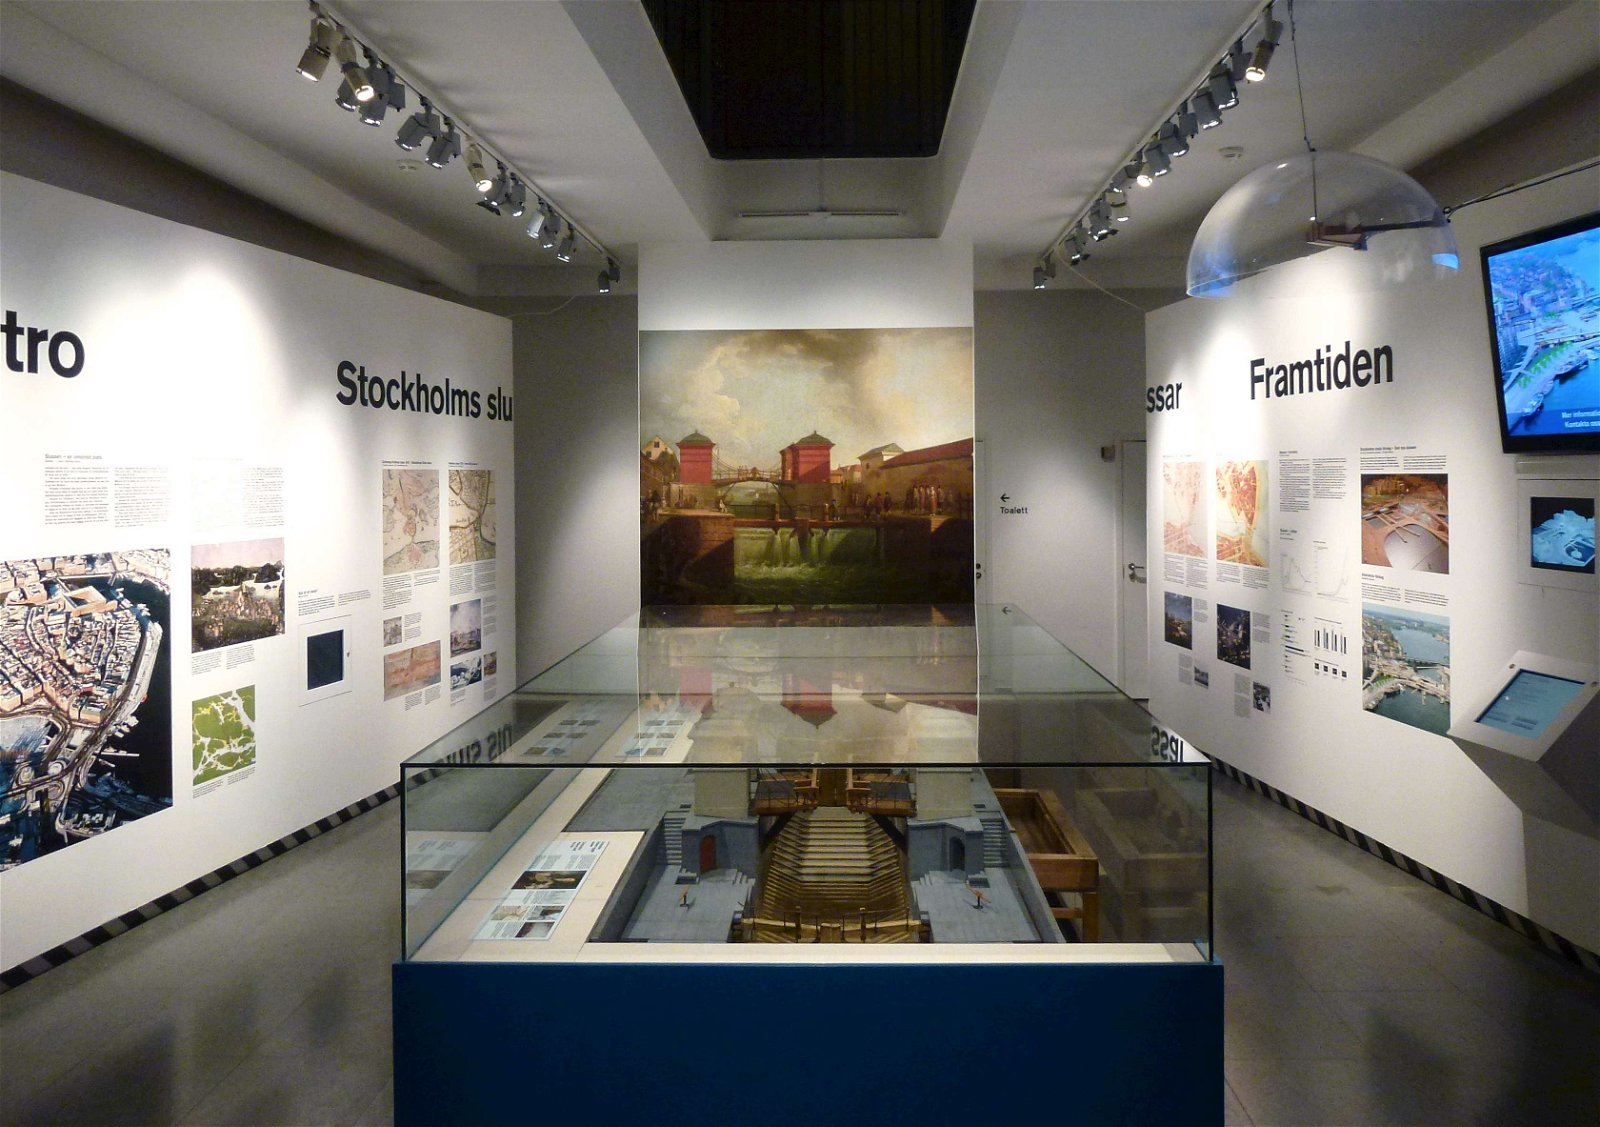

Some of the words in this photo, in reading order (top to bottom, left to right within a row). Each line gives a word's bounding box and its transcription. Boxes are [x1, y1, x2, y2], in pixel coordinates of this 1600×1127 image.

[0, 310, 85, 378] tro
[1250, 341, 1394, 400] Framtiden
[336, 360, 482, 419] Stockholms
[487, 387, 513, 422] slu
[1146, 382, 1182, 413] ssar
[1000, 506, 1028, 514] Toalett
